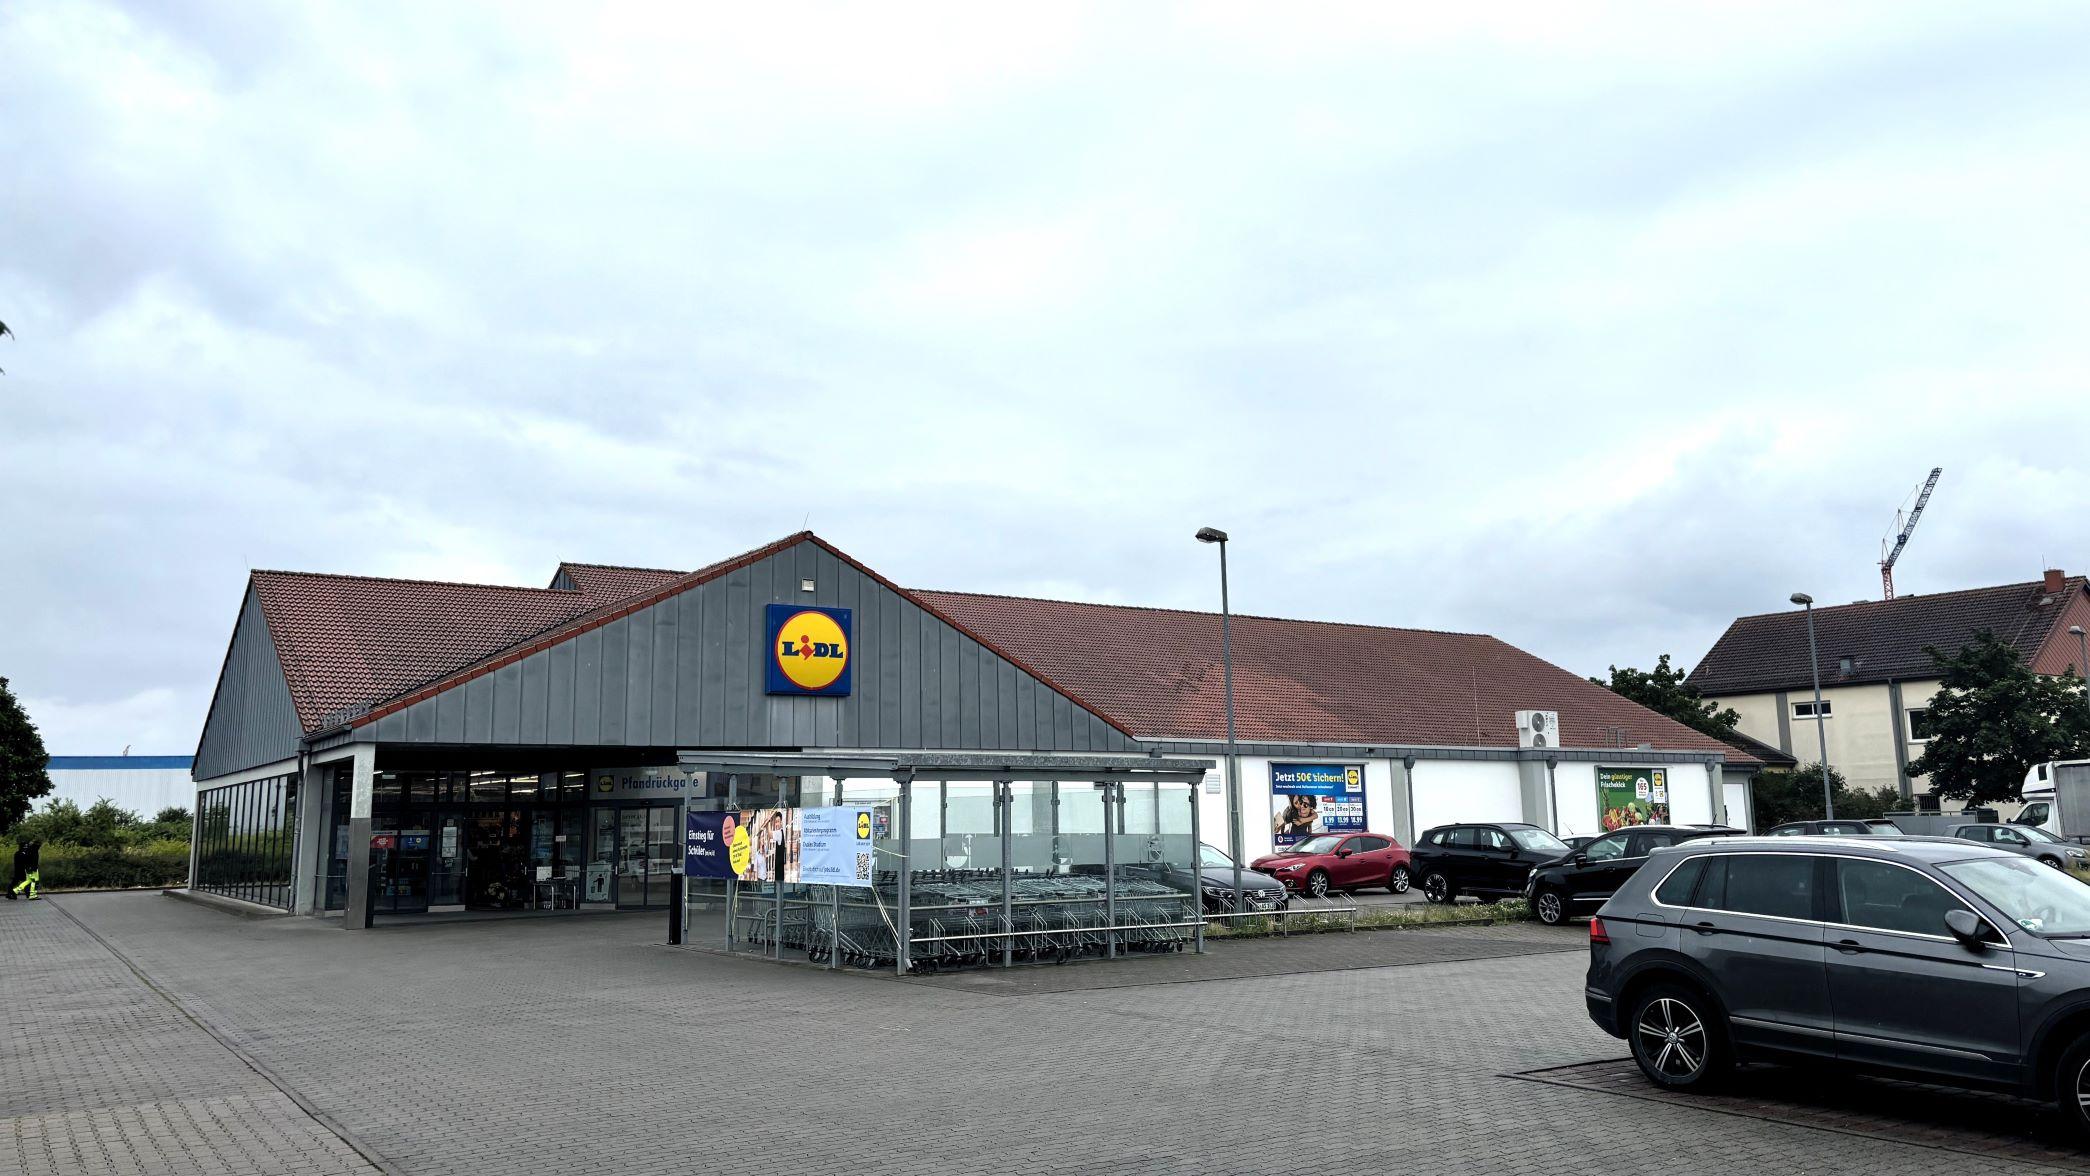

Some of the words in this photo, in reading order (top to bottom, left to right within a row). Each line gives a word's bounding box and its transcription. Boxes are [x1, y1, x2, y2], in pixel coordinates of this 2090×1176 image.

[1275, 772, 1295, 782] Jetzt
[1296, 772, 1312, 782] 50€
[621, 775, 699, 791] Pfandrückgae
[688, 830, 706, 842] Einstieg
[688, 845, 705, 856] Schüler
